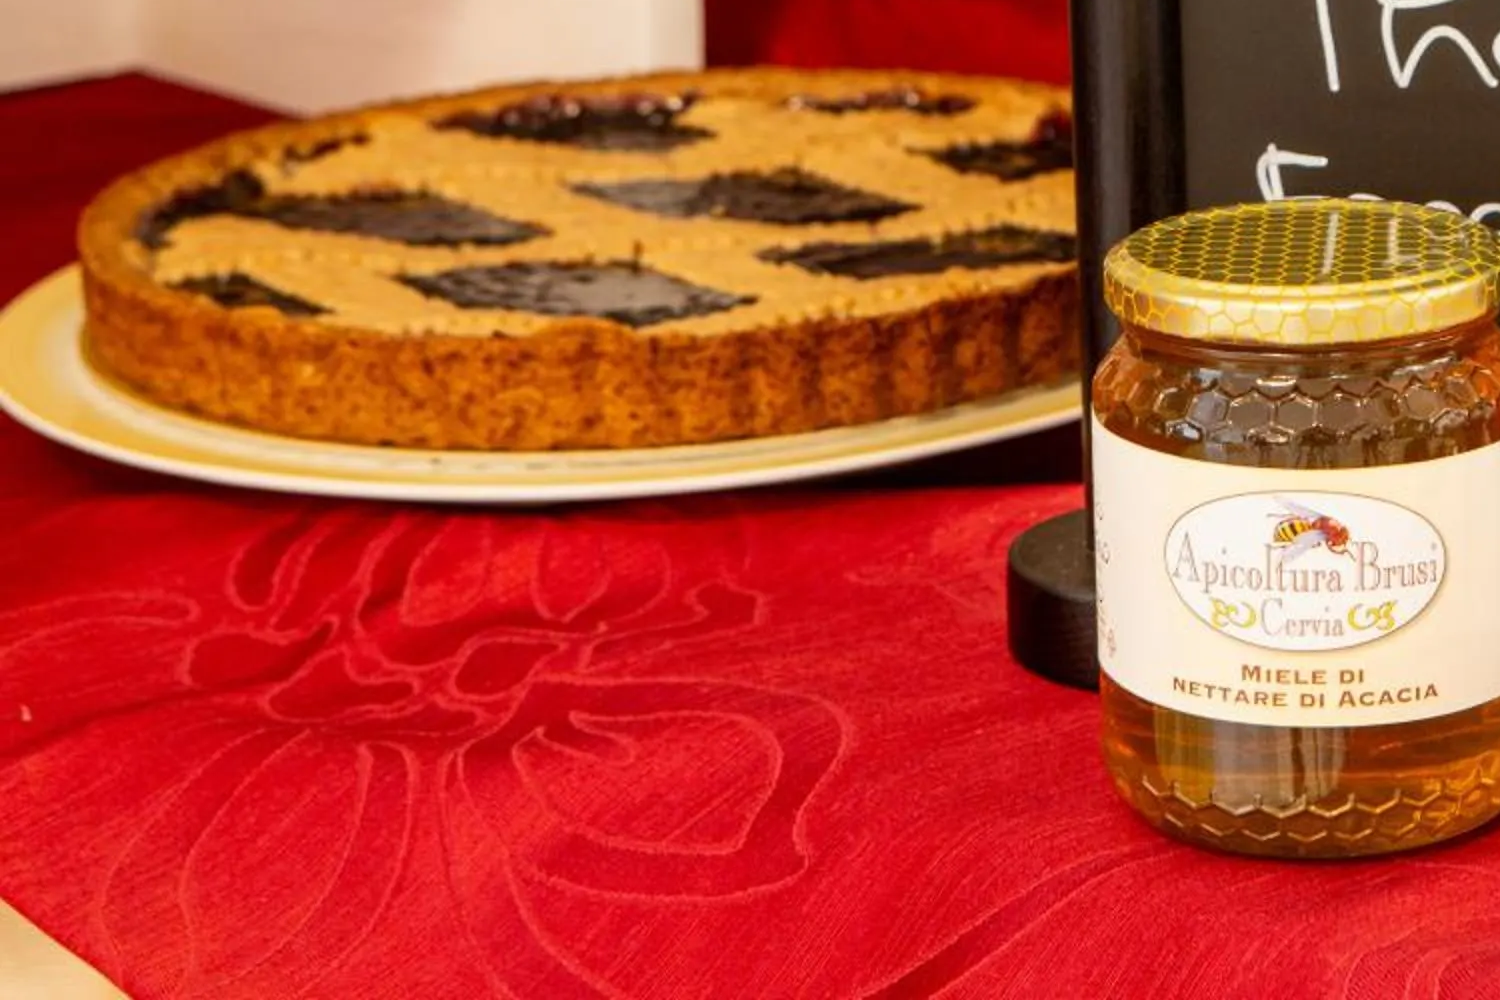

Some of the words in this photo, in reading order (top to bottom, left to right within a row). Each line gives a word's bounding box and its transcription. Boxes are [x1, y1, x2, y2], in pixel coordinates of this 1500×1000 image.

[1172, 531, 1344, 594] Apicoltura
[1352, 540, 1439, 593] Brusi
[1260, 597, 1345, 638] Cervia
